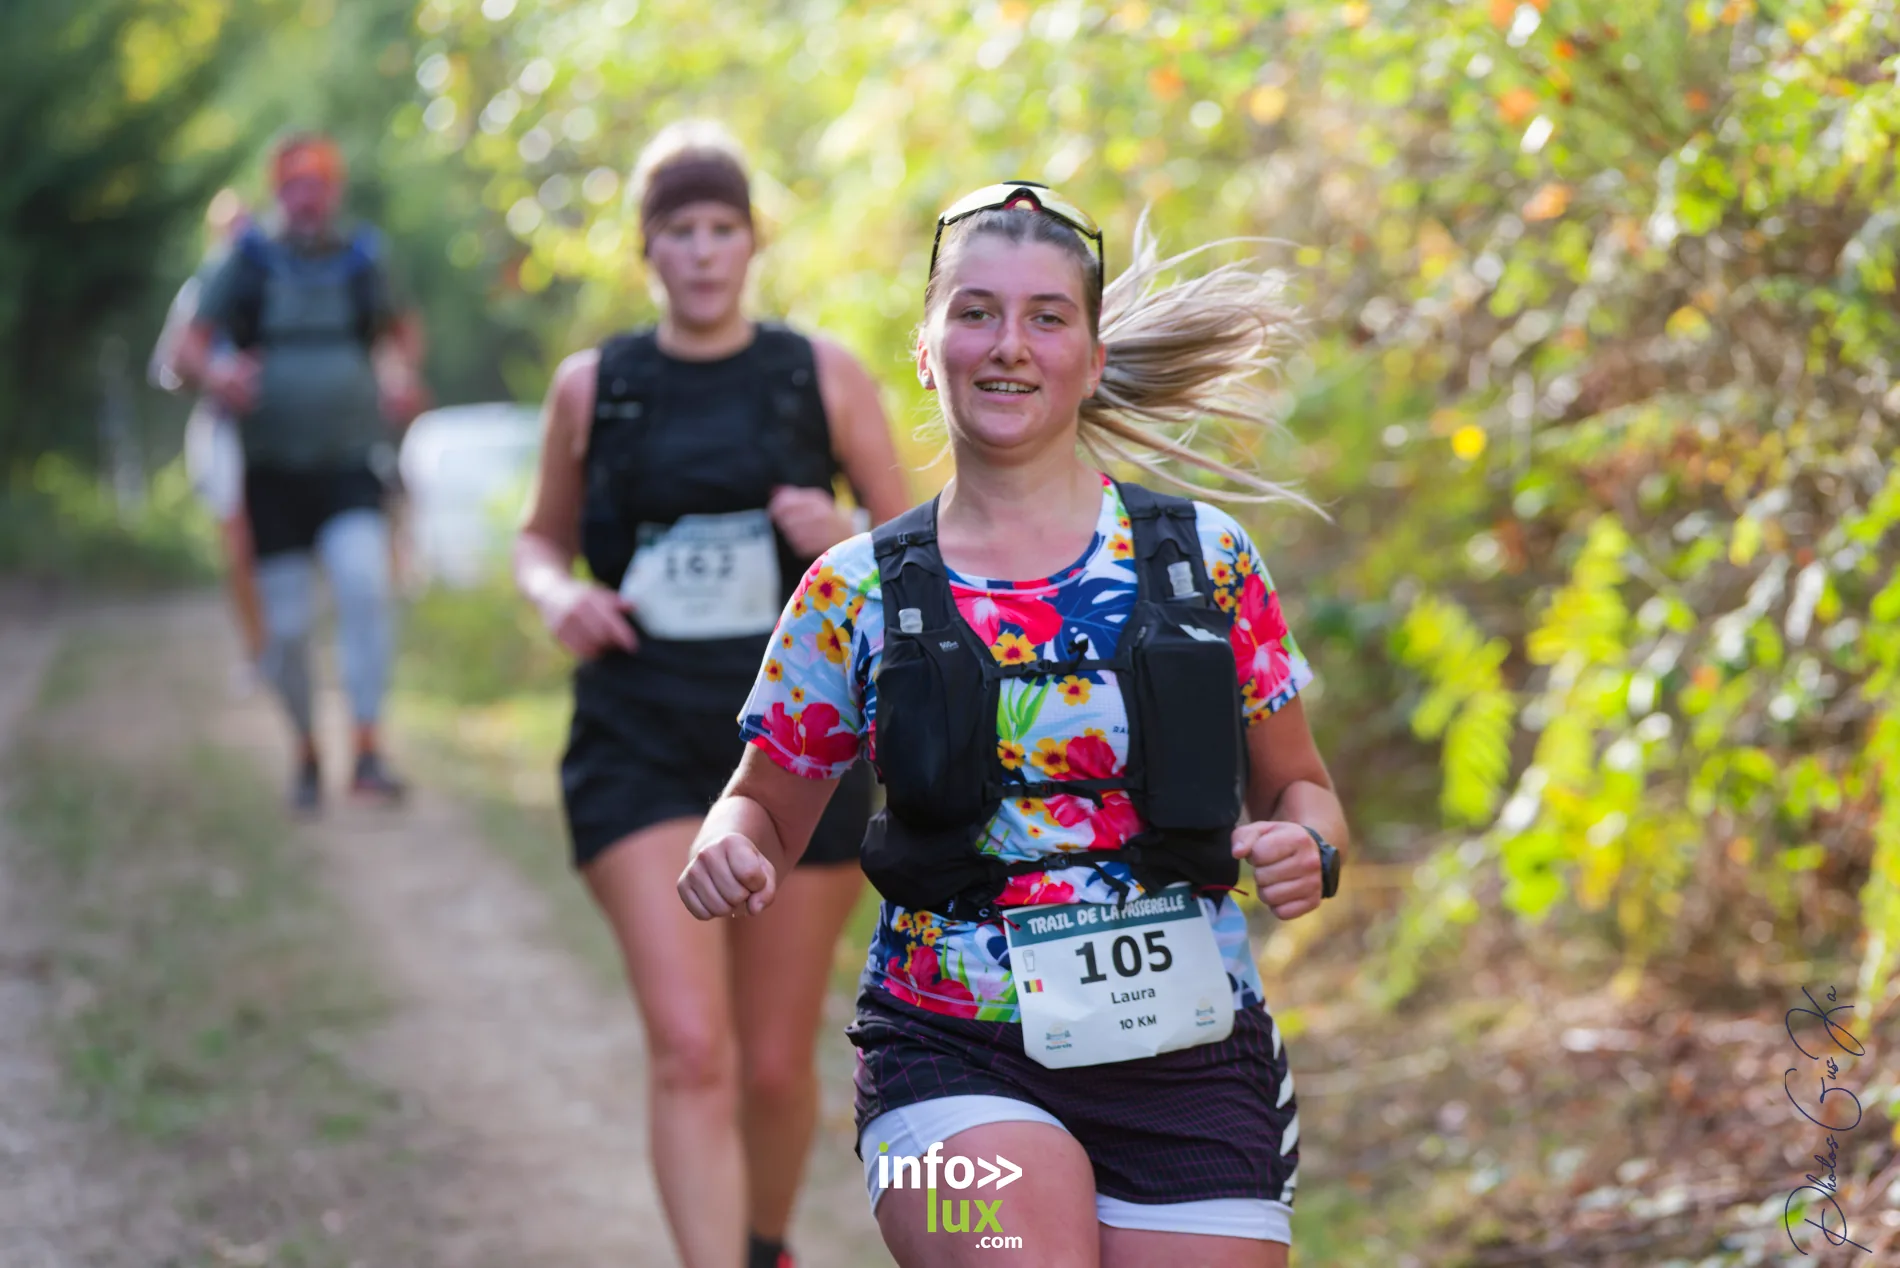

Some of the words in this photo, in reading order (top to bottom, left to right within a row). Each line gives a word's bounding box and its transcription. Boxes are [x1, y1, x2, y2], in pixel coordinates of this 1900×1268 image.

[1027, 912, 1075, 935] TRAIL
[1077, 907, 1098, 926] DE
[1100, 905, 1120, 922] LA
[1121, 894, 1185, 920] PASSERELLE
[1075, 930, 1173, 985] 105
[1111, 987, 1156, 1004] Laura
[1119, 1018, 1134, 1031] 10
[1137, 1015, 1157, 1028] KM
